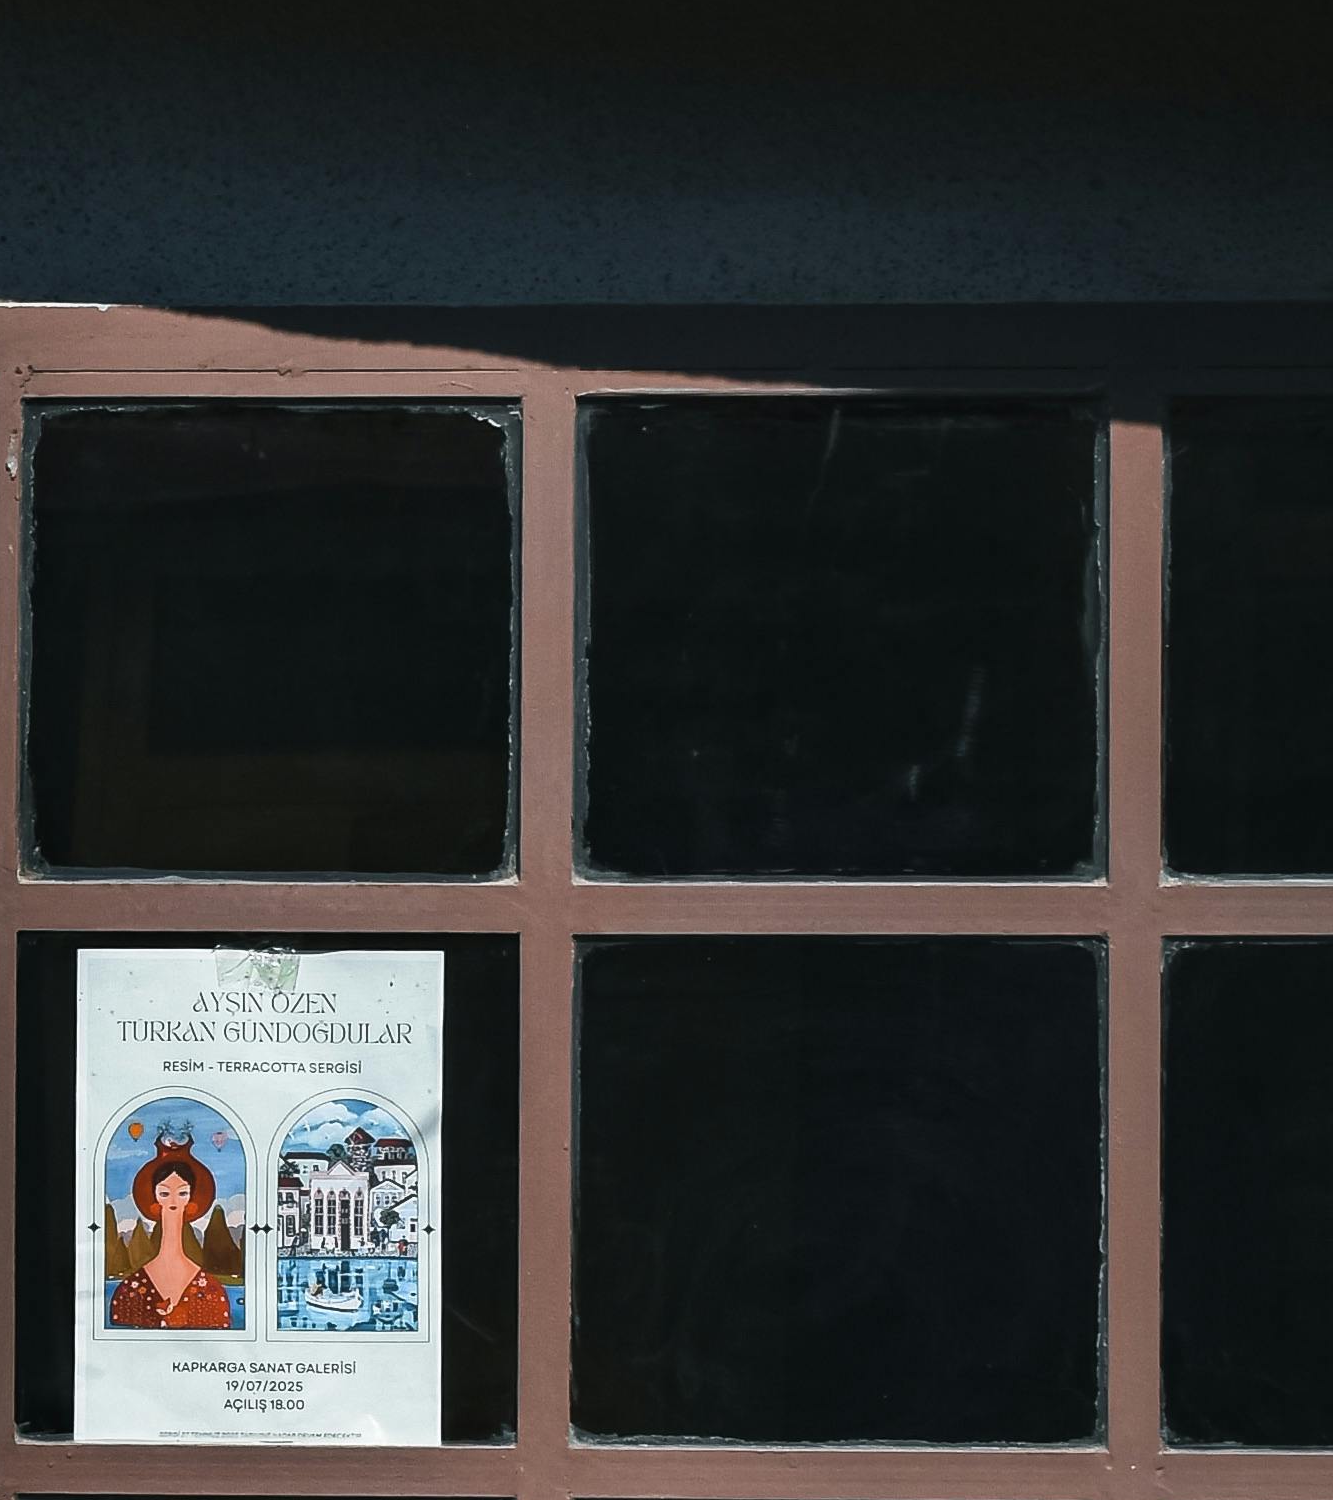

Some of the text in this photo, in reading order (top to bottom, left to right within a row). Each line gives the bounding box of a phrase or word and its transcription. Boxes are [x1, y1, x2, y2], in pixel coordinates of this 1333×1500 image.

[116, 1018, 413, 1044] TÜRKAN GÜNDOĞDULAR
[163, 1058, 204, 1073] RESİM
[216, 1061, 306, 1074] TERRACOTTA
[309, 1060, 362, 1075] SERGİSİ
[172, 1360, 357, 1375] KAPKARGA SANAT GALERİSİ
[225, 1380, 304, 1392] 19/07/2025
[223, 1398, 306, 1413] AÇILIŞ 18.00
